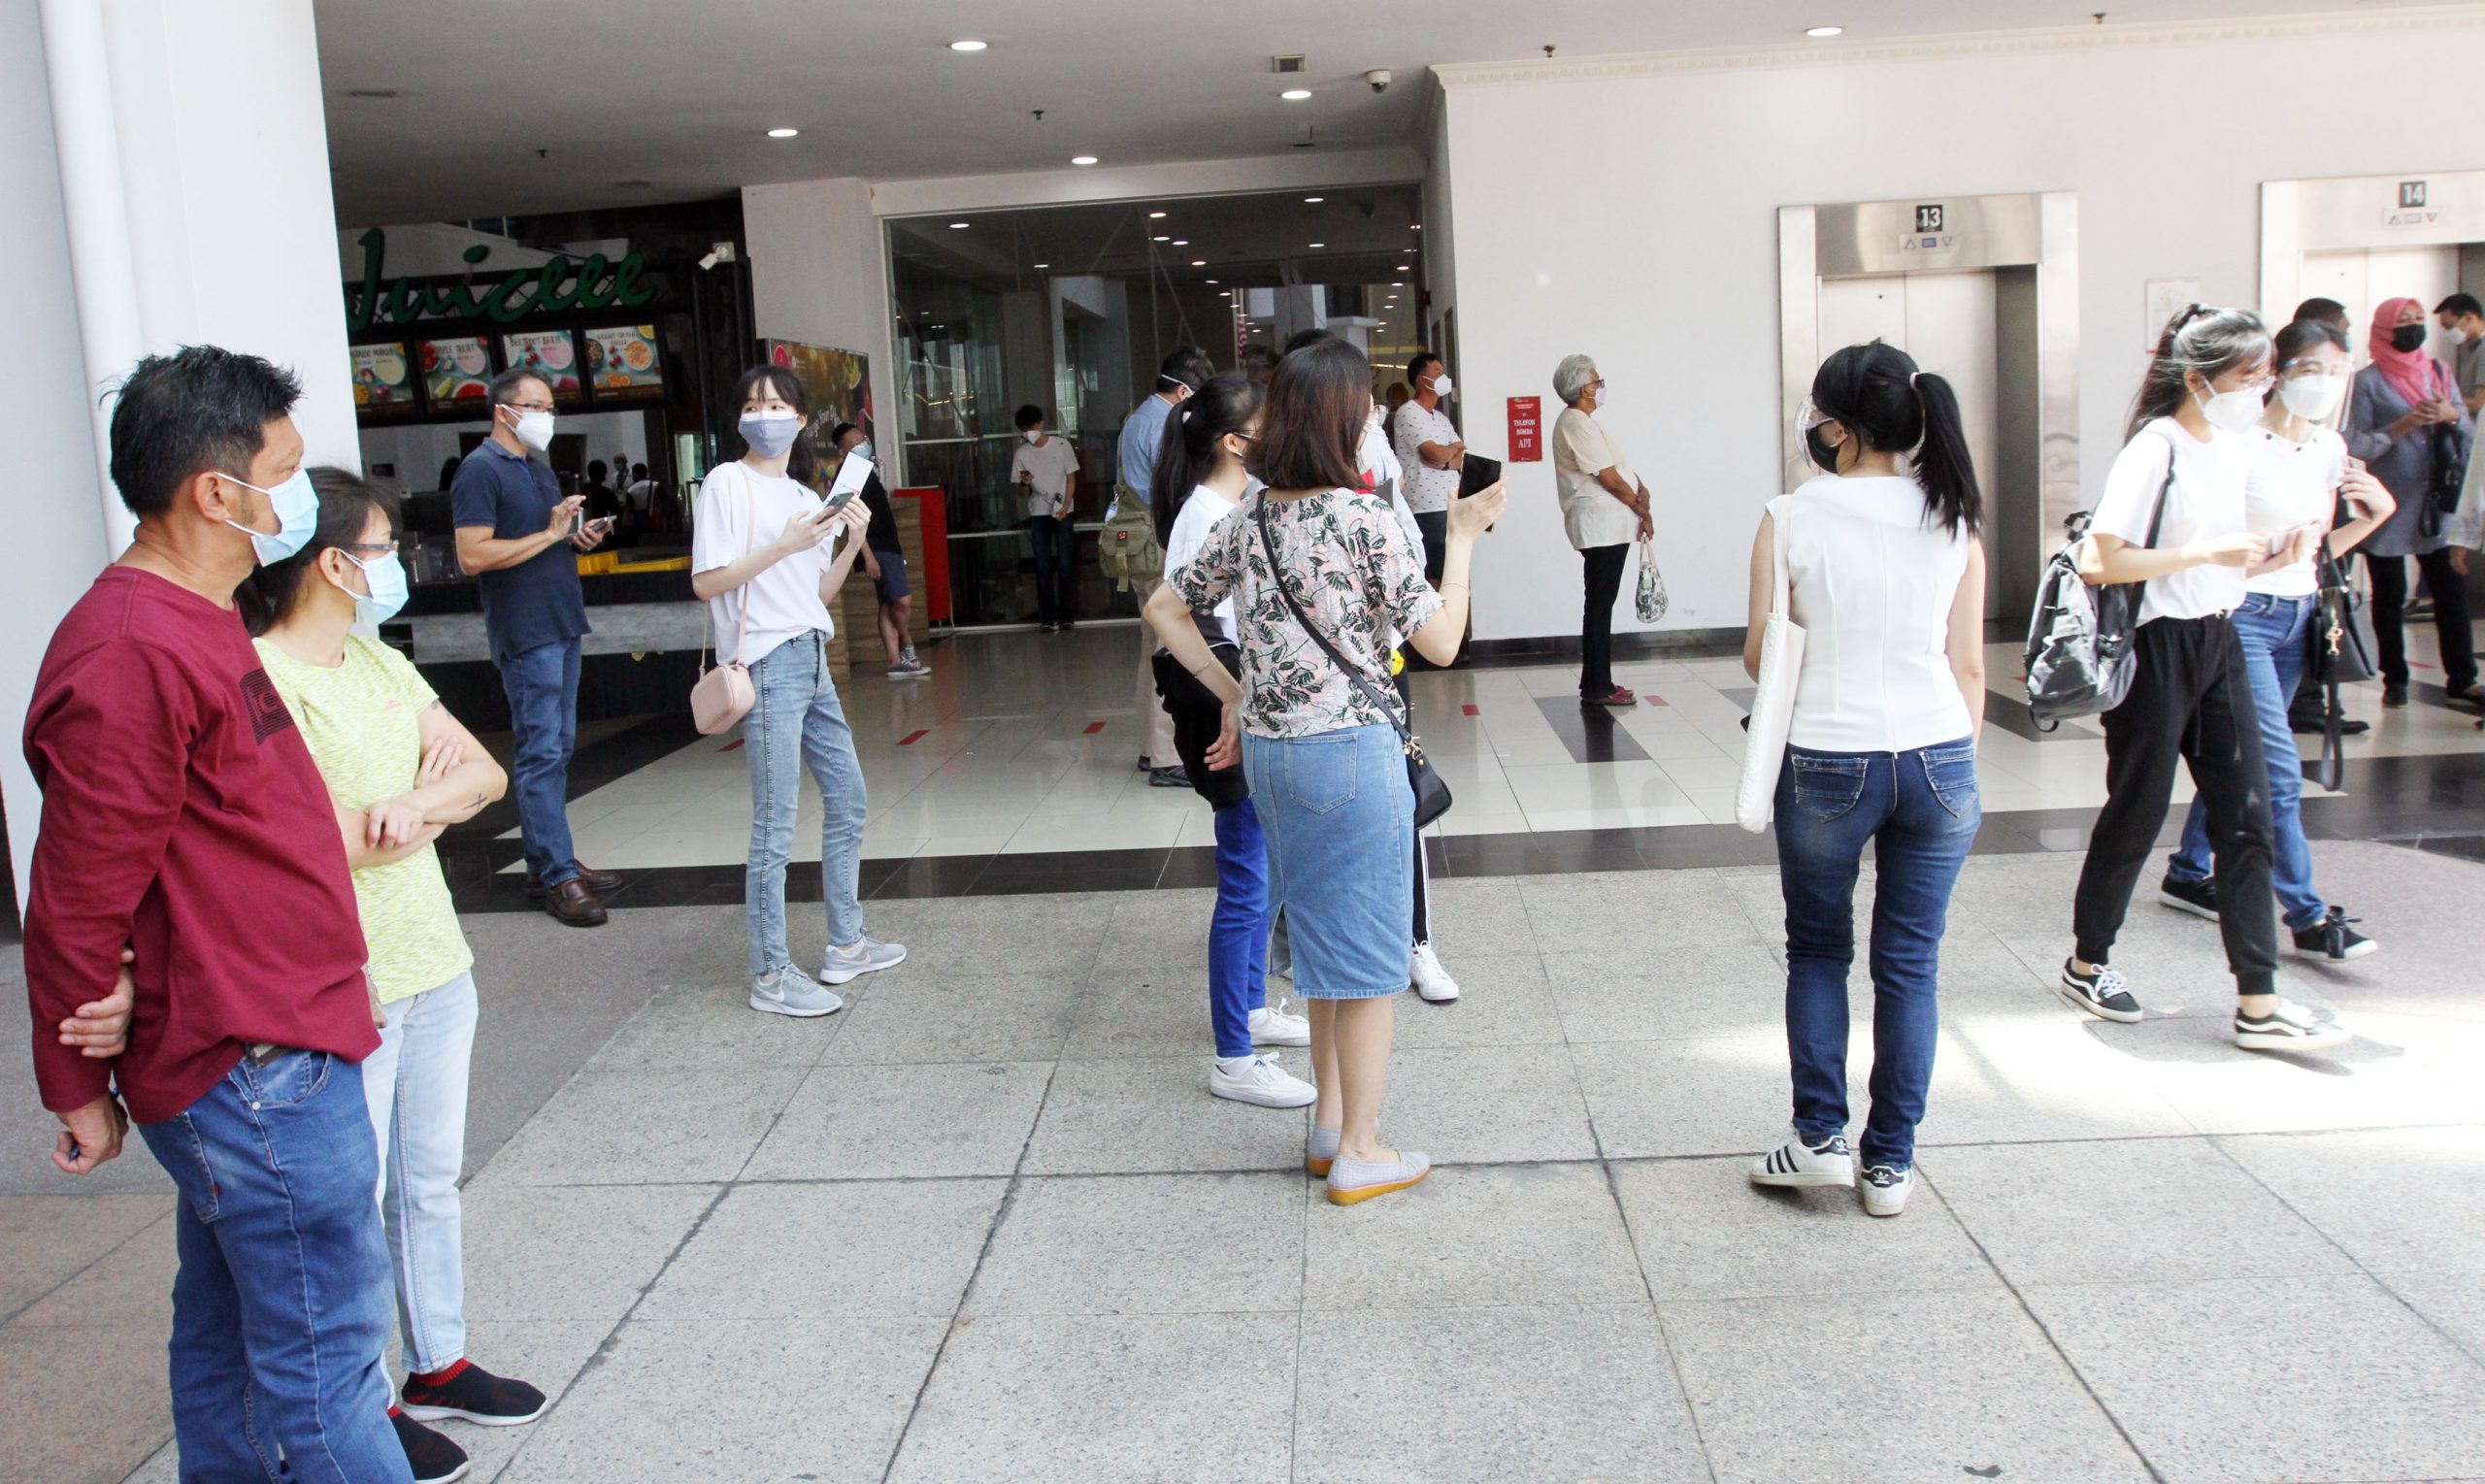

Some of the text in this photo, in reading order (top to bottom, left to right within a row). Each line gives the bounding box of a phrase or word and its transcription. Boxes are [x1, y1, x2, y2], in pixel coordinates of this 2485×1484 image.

[2403, 183, 2424, 204] 14
[1921, 207, 1941, 227] 13
[1518, 438, 1532, 448] API
